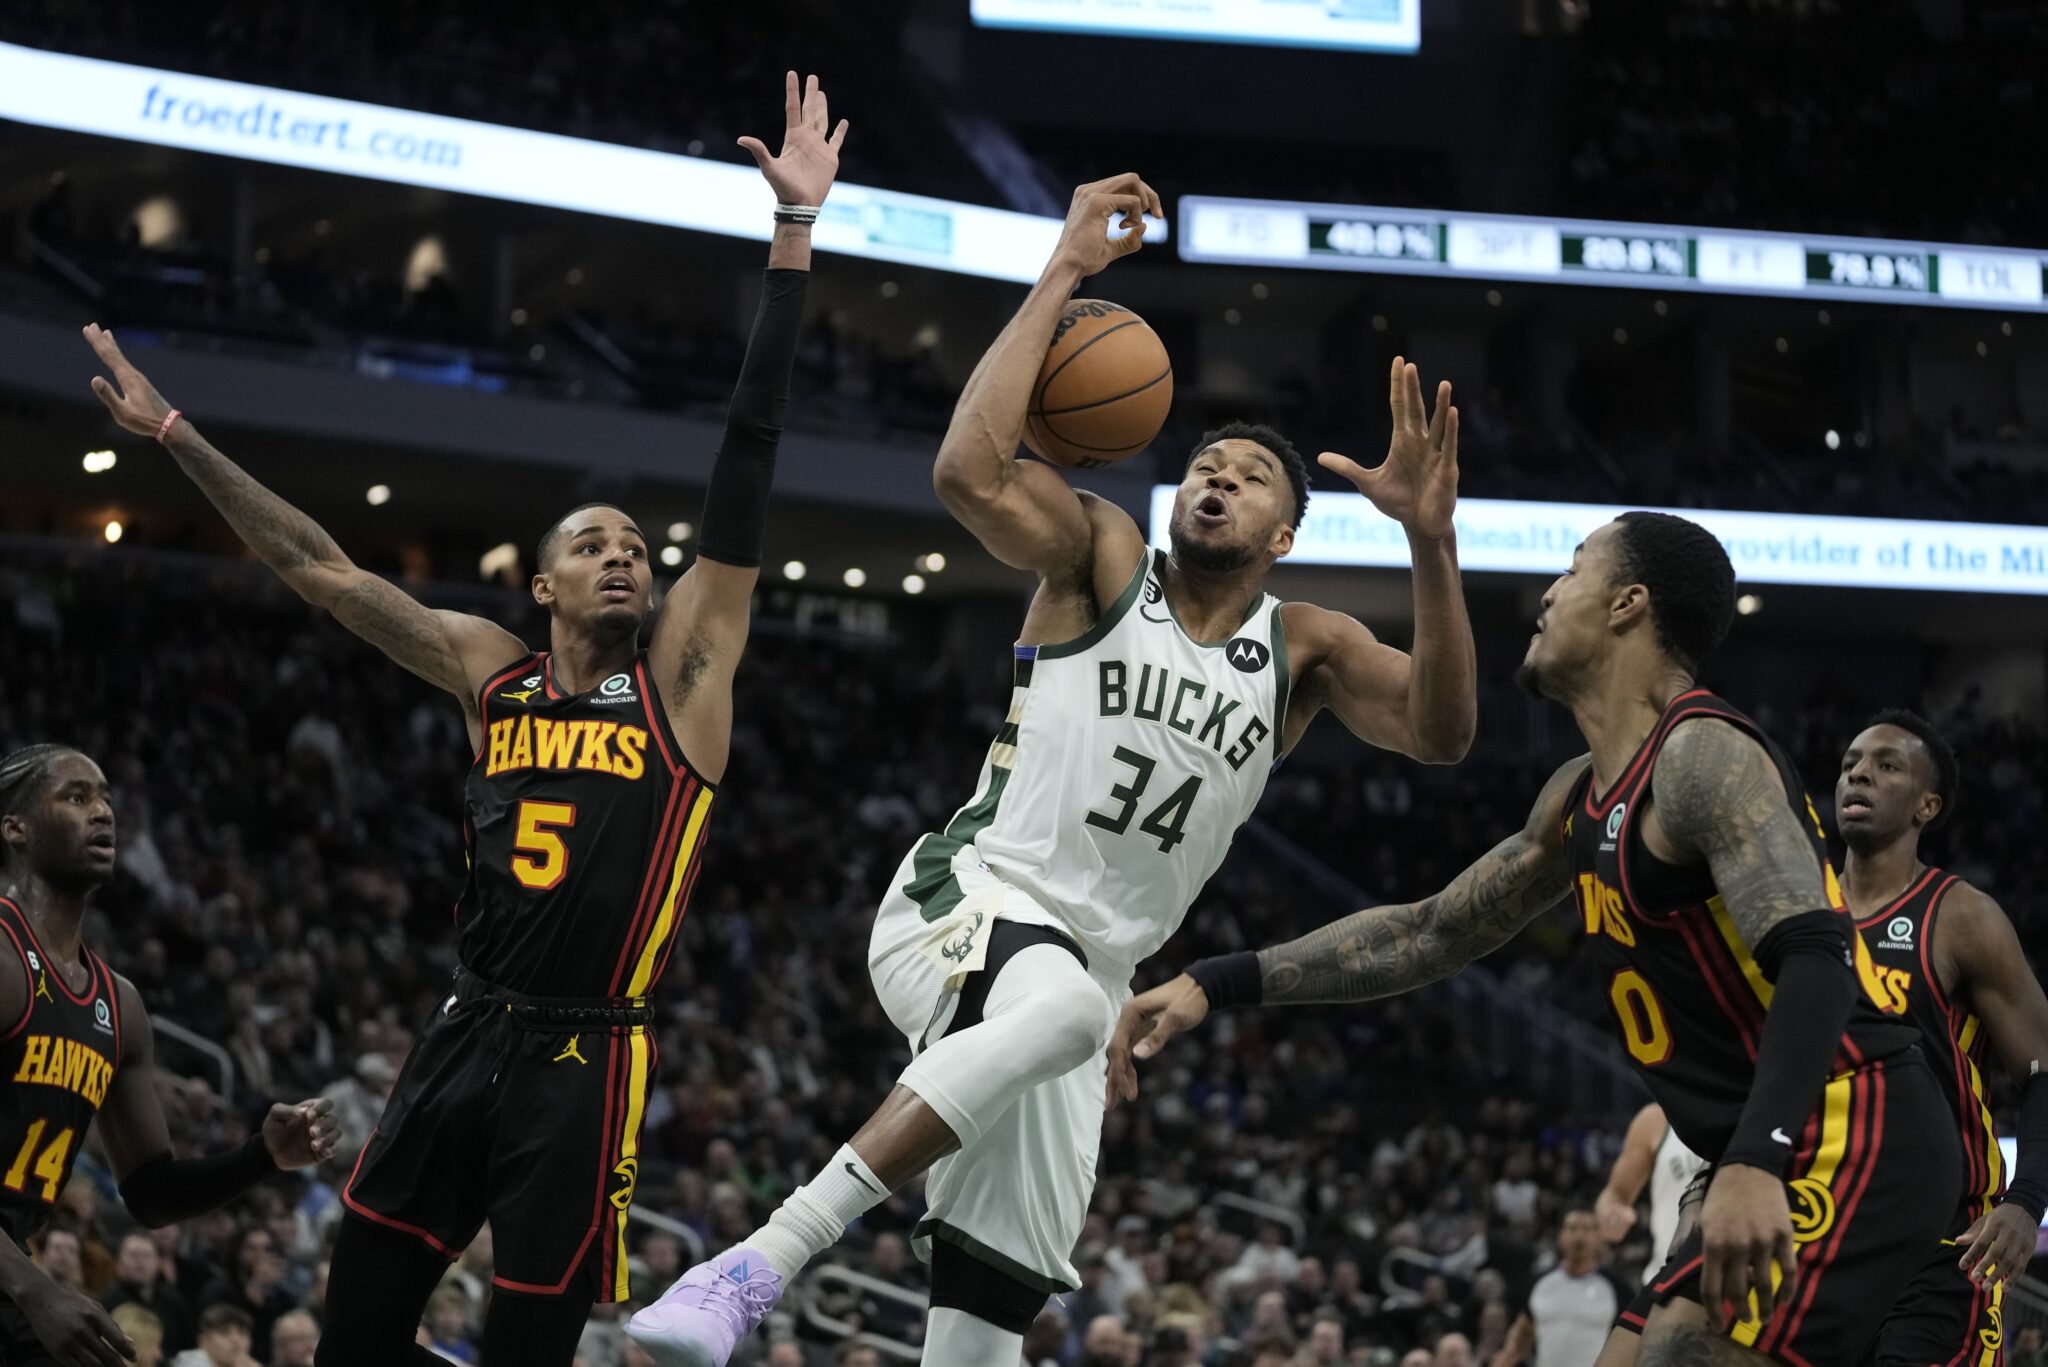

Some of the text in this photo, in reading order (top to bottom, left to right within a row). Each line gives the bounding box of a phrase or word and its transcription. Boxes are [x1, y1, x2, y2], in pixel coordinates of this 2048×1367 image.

[141, 84, 462, 168] froedtert.com
[1725, 533, 1861, 568] rovider
[1878, 539, 1913, 569] of
[1927, 542, 1988, 571] the
[590, 695, 637, 704] sharecare
[1099, 659, 1270, 773] BUCKS
[486, 713, 648, 780] HAWKS
[1084, 744, 1204, 854] 34
[511, 799, 577, 890] 5
[13, 1035, 114, 1111] HAWKS
[3, 1117, 76, 1205] 14
